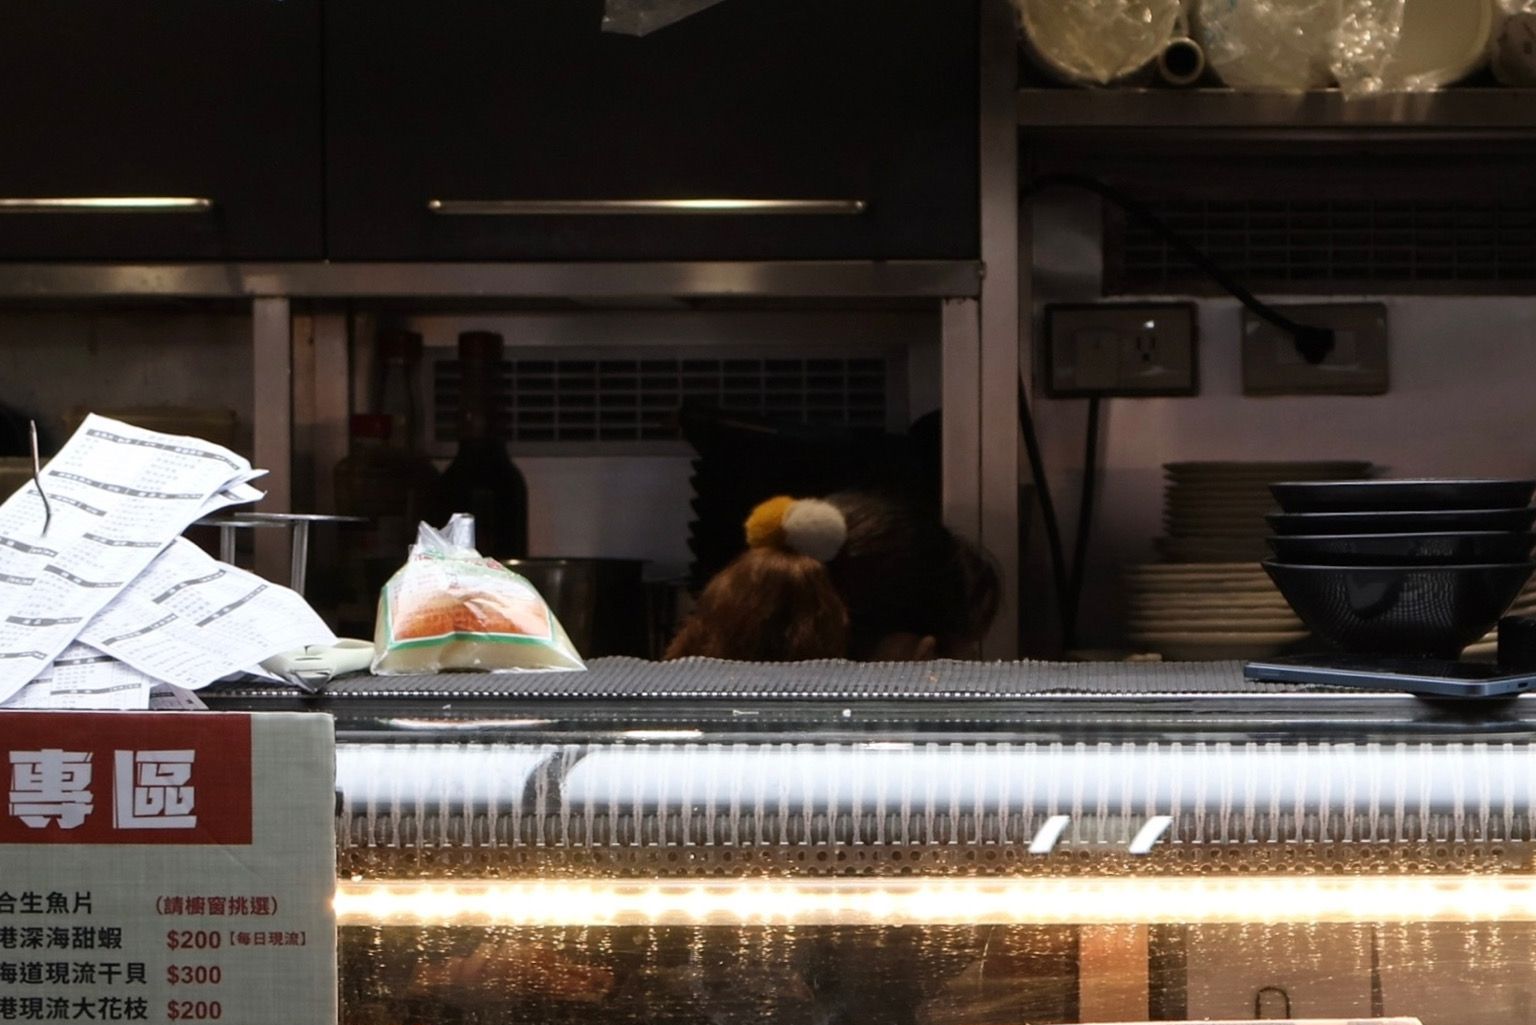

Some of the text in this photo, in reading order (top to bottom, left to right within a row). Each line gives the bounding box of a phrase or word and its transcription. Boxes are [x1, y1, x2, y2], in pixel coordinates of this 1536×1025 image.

[9, 749, 197, 829] 專區
[0, 891, 92, 914] 合生魚片
[167, 929, 221, 951] $200
[167, 964, 222, 986] $300
[167, 999, 222, 1021] $200
